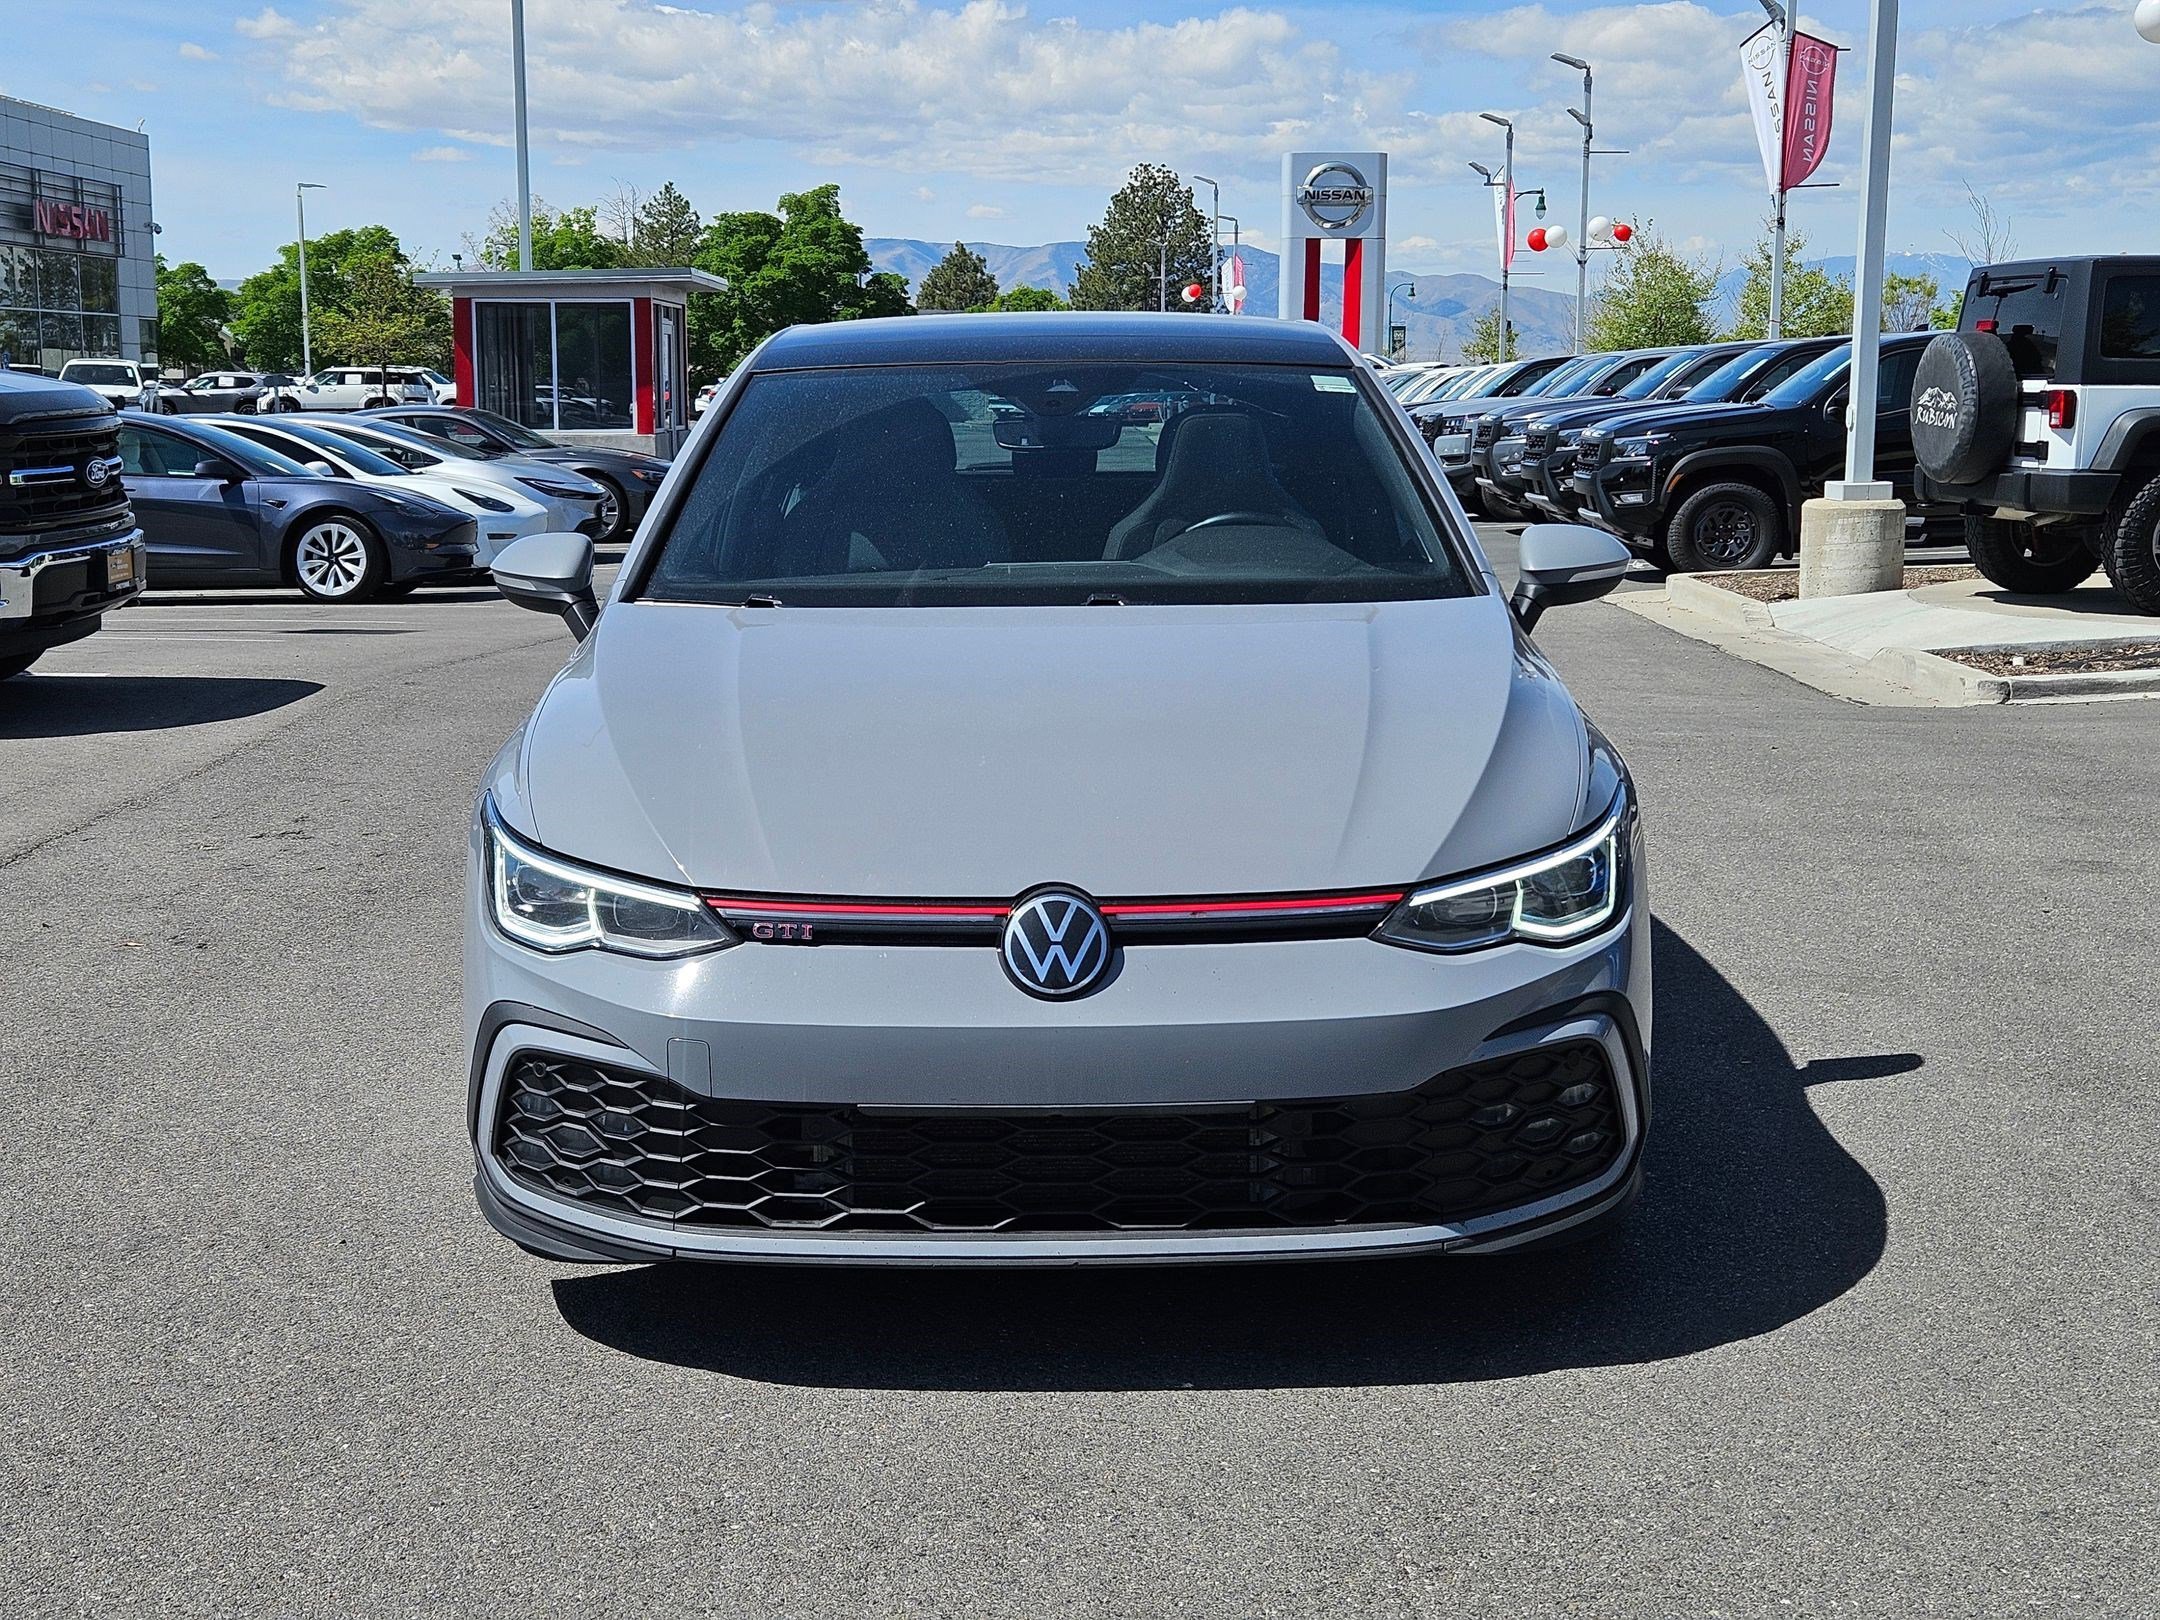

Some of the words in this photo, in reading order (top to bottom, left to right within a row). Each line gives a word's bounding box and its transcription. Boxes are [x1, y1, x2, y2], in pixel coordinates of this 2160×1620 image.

[1748, 40, 1777, 64] NISSAN
[1762, 71, 1781, 140] SSAN
[1304, 190, 1366, 201] NISSAN
[33, 198, 109, 242] NISSAN
[1915, 406, 1958, 429] RUBICON
[753, 922, 813, 939] GTI
